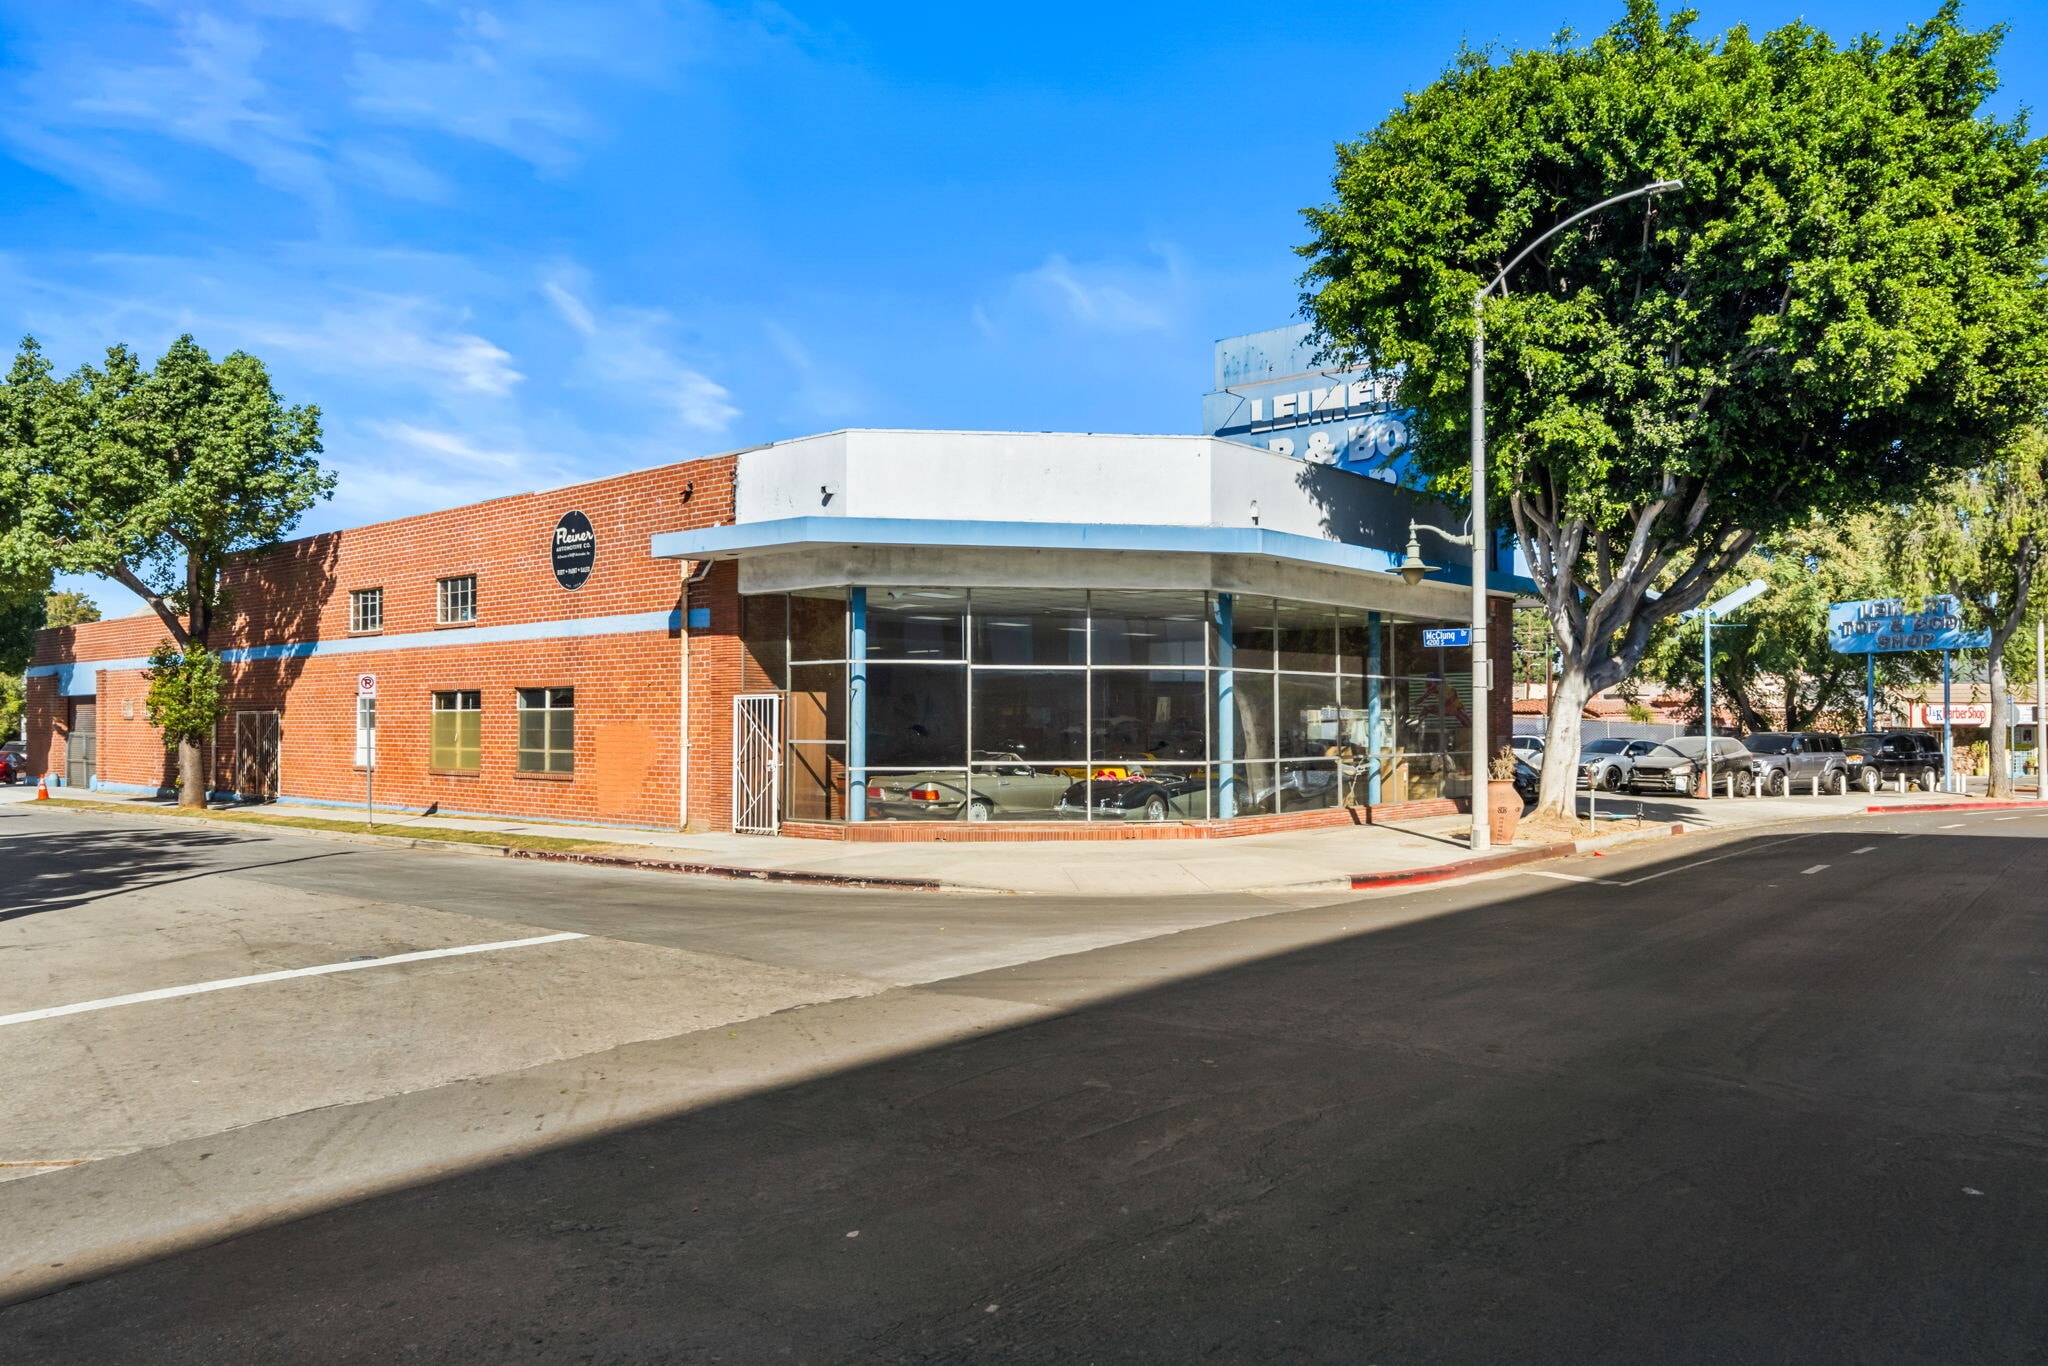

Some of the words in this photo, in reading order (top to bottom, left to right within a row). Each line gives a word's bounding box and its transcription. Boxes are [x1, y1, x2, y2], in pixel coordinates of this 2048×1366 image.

[1251, 376, 1404, 433] LEIMER
[1304, 431, 1339, 465] &
[1349, 420, 1408, 462] BO
[1842, 620, 1880, 636] TOP
[1891, 617, 1904, 633] &
[1426, 631, 1455, 642] McClung
[1877, 632, 1935, 649] SHOP
[1967, 706, 1985, 722] Shop
